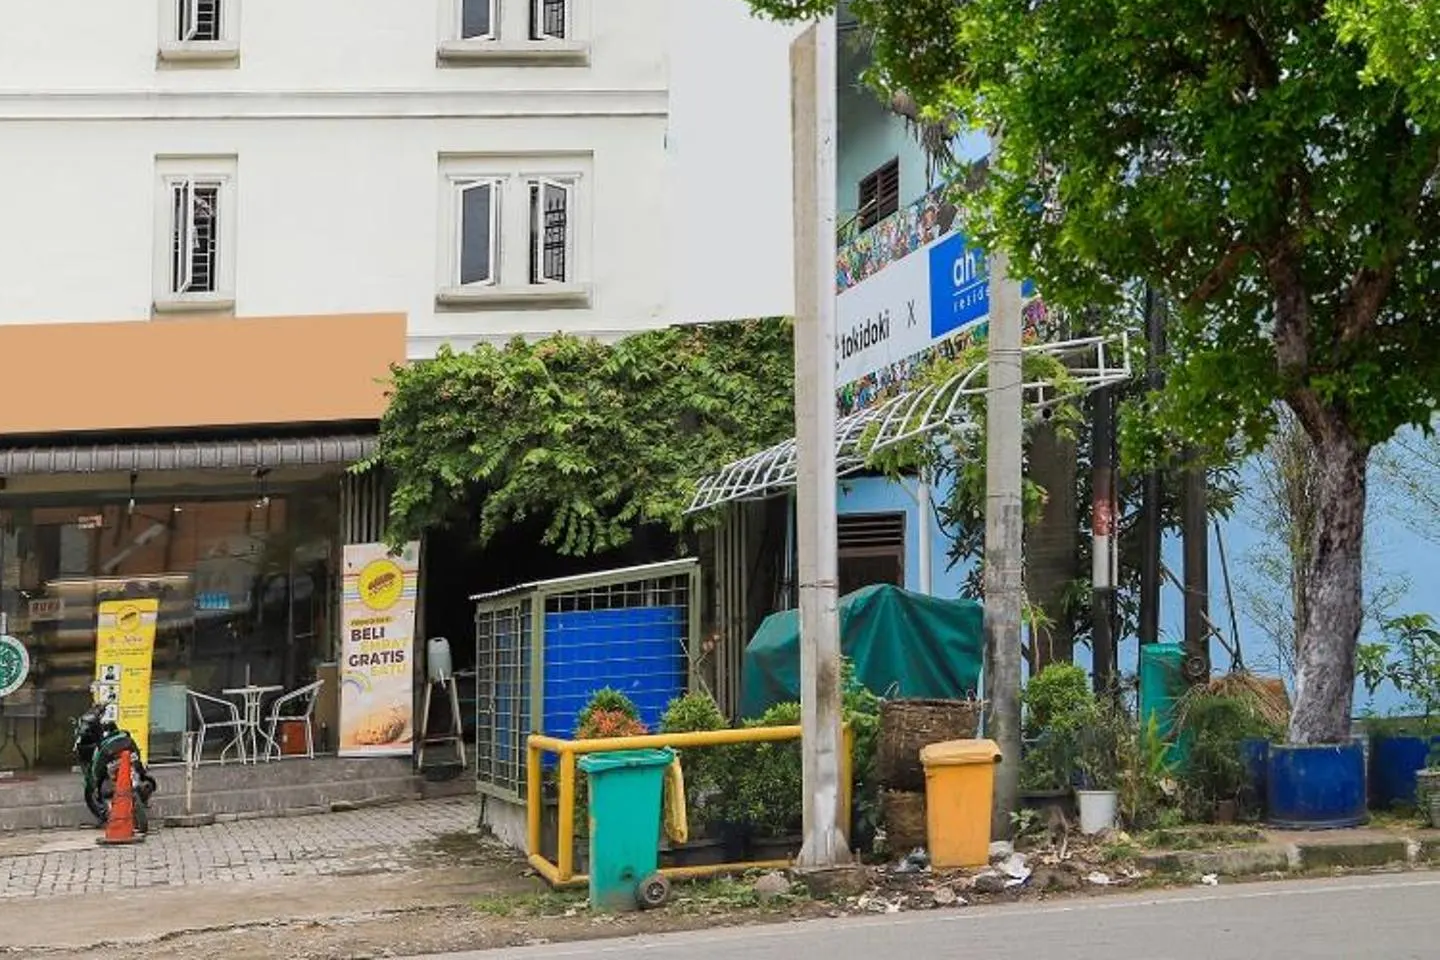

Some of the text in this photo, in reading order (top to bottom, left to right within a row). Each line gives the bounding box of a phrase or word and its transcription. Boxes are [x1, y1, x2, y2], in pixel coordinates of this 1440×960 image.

[841, 308, 890, 360] tokidoki
[351, 626, 385, 642] BELI
[349, 650, 405, 667] GRATIS
